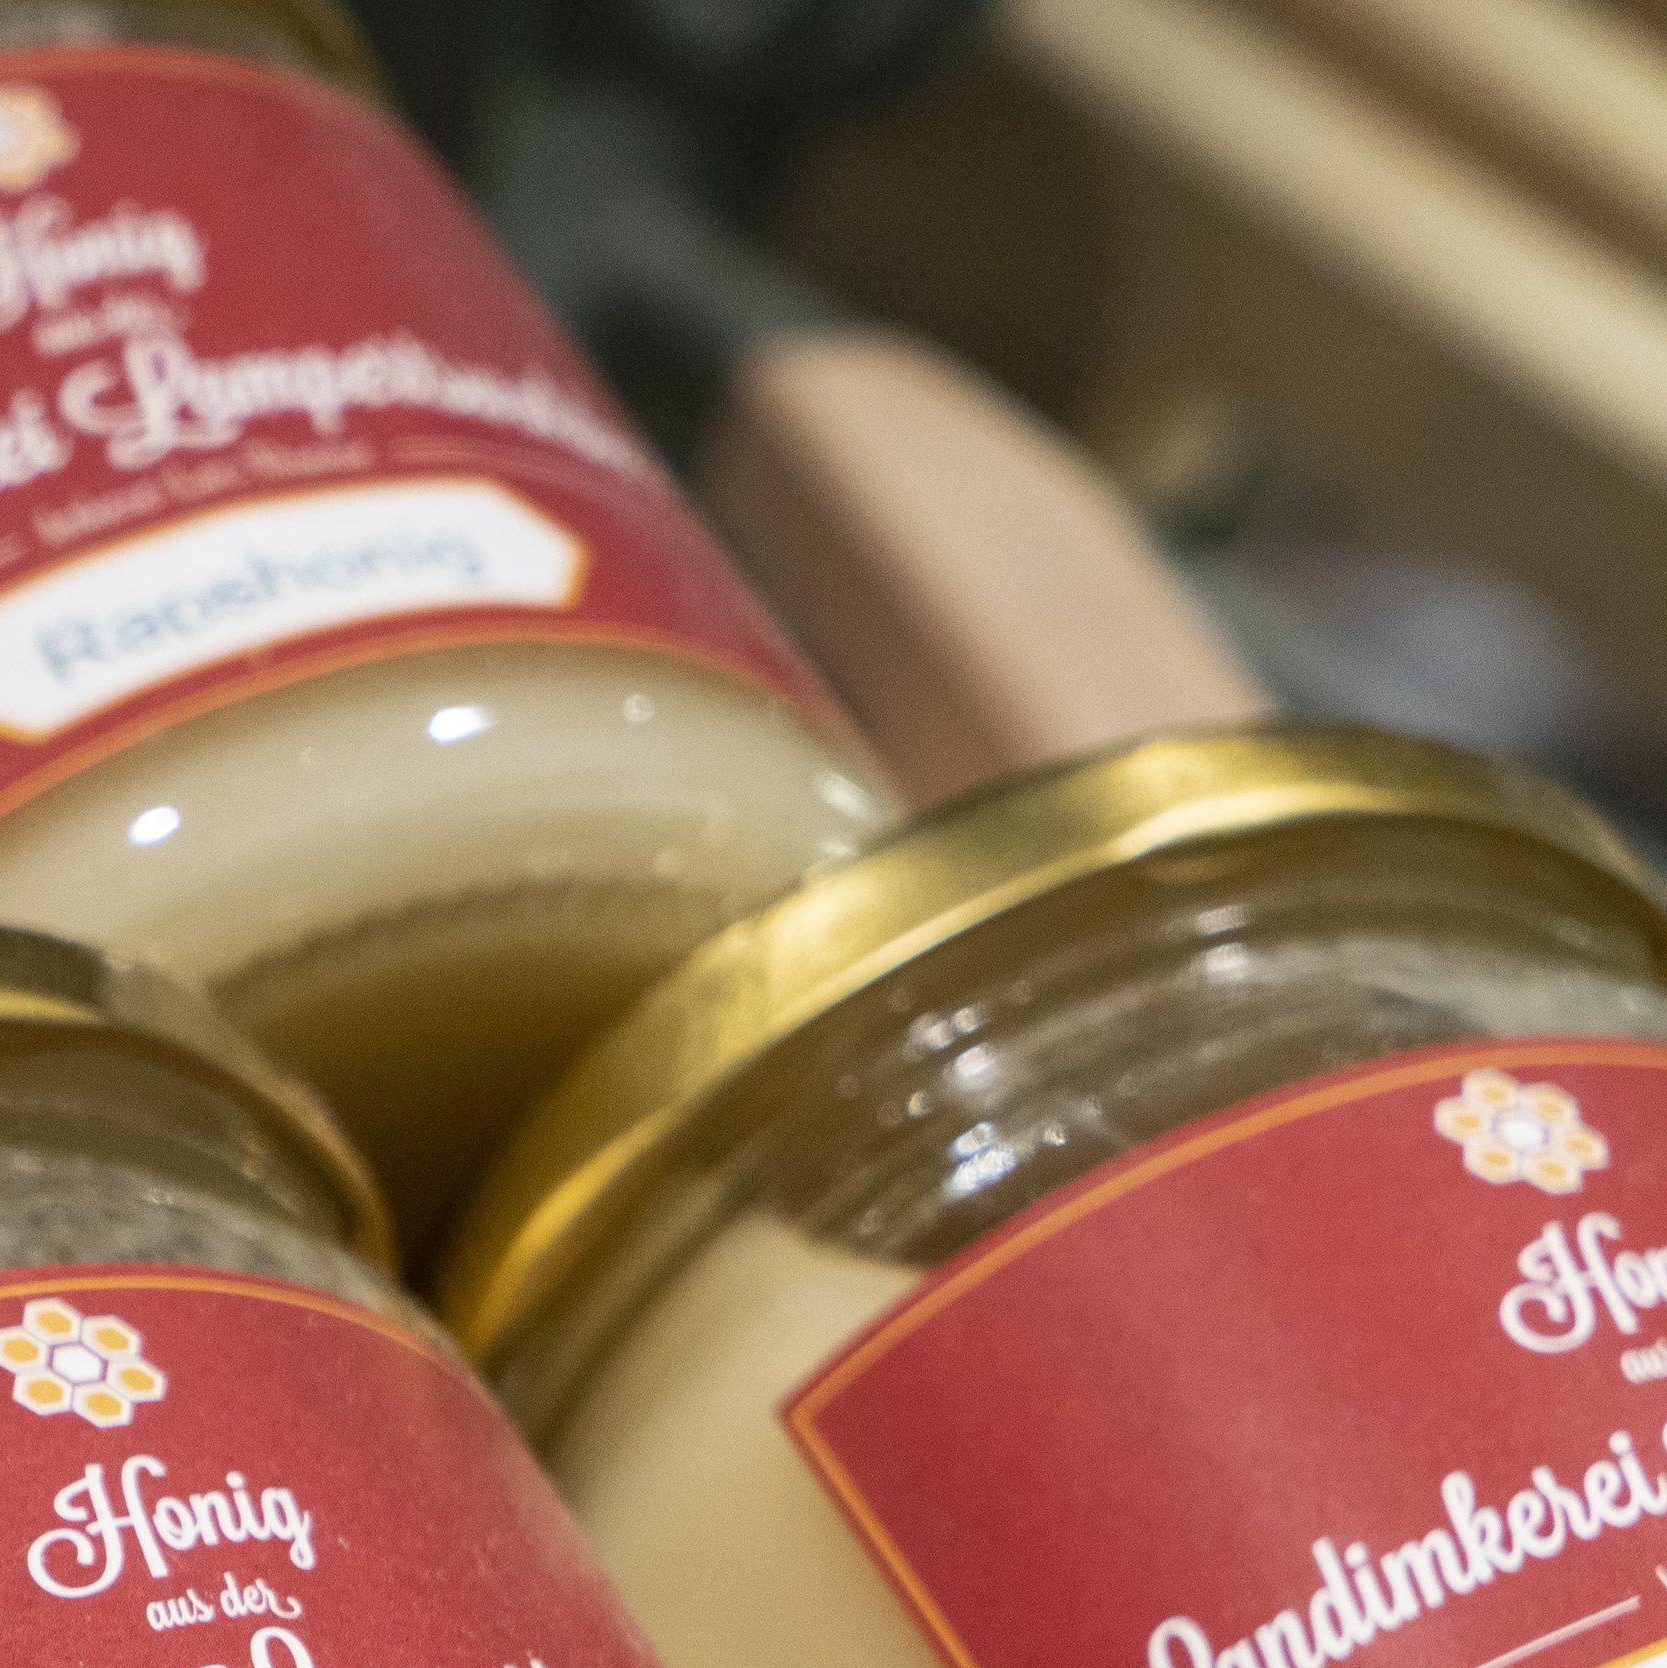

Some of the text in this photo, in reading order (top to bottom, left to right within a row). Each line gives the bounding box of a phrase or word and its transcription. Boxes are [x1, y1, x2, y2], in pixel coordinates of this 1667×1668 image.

[25, 1453, 317, 1600] Honig
[147, 1571, 302, 1631] aus der
